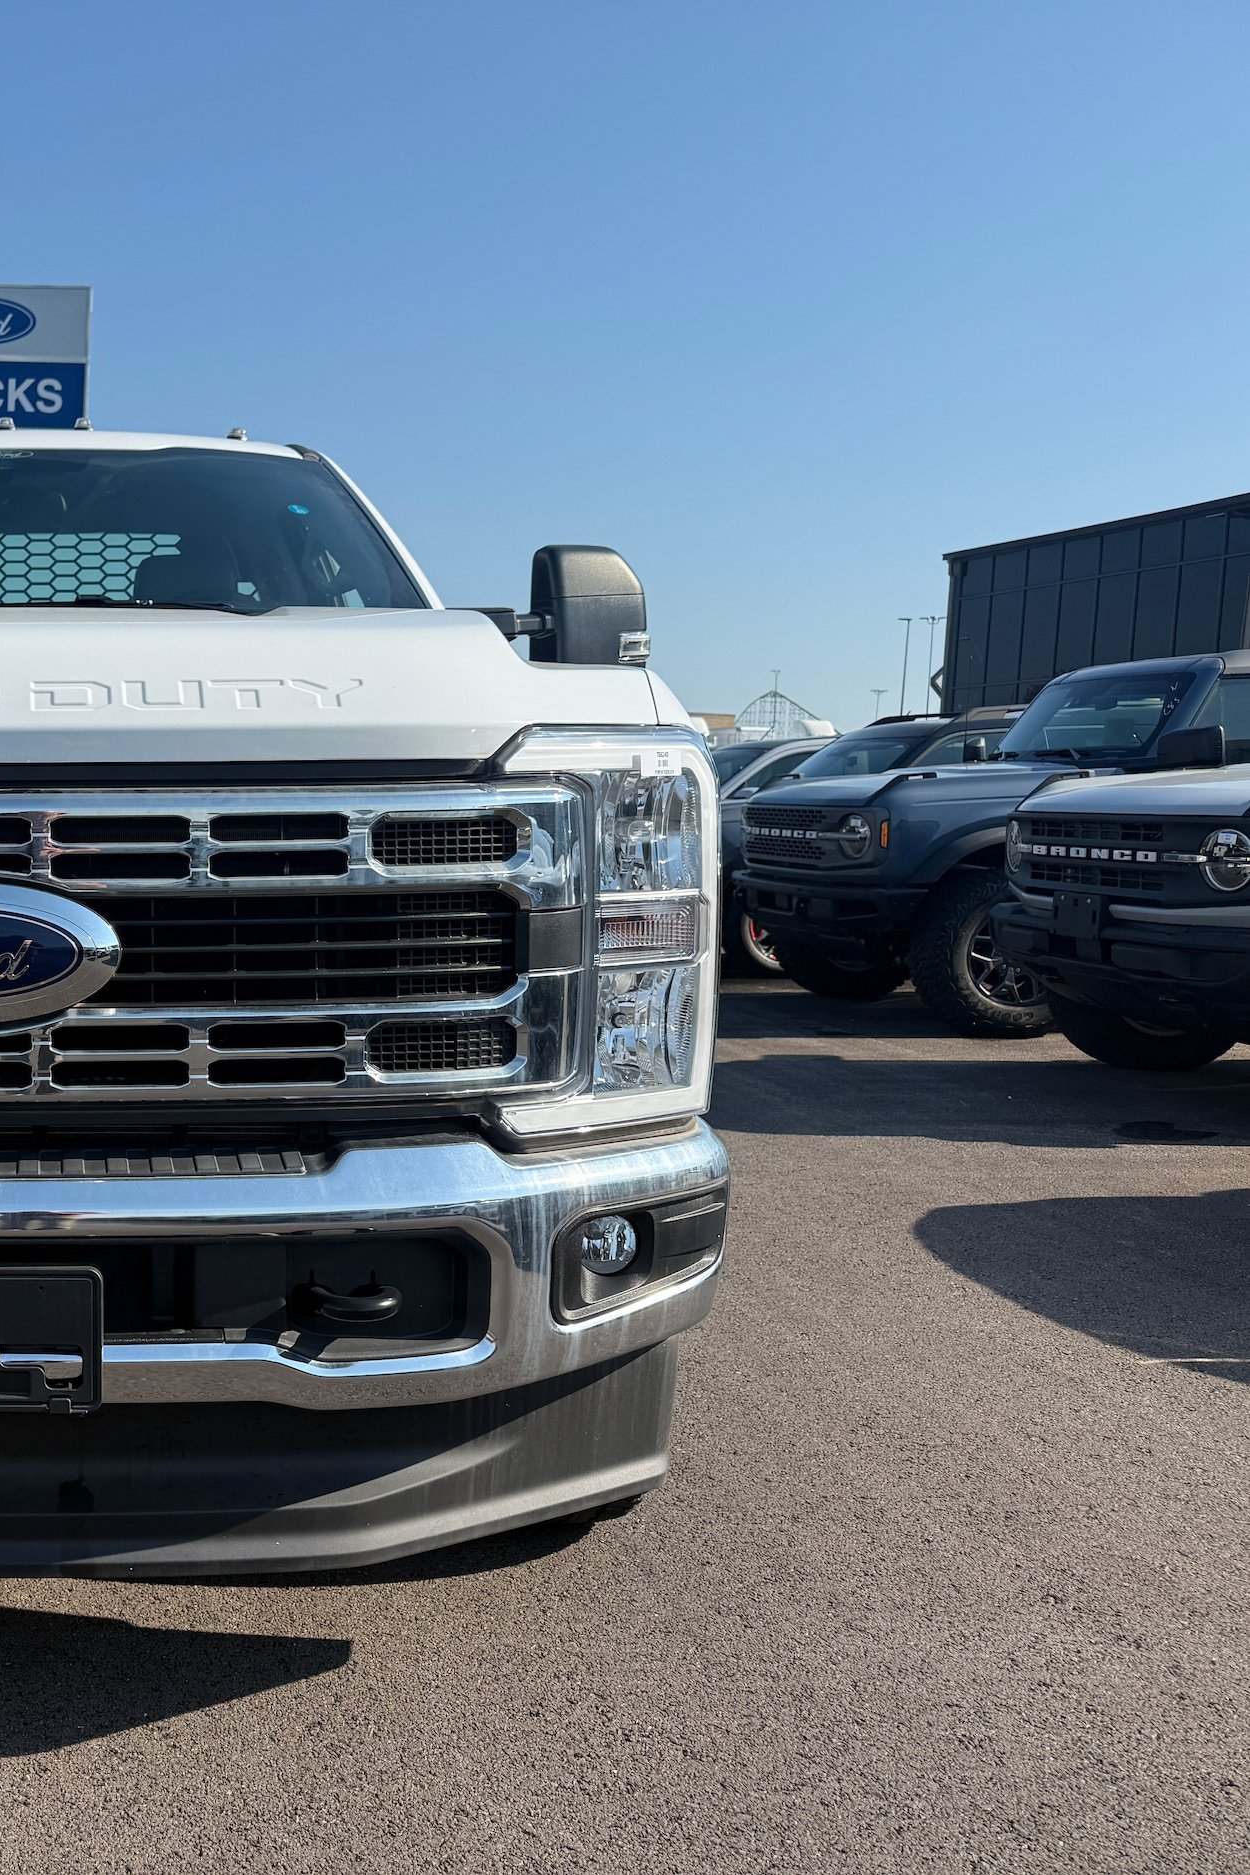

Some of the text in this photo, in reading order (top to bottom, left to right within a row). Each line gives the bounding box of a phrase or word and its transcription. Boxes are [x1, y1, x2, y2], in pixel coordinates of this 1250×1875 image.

[30, 678, 364, 712] DUTY
[751, 826, 818, 839] BRONCO
[1032, 844, 1158, 863] BRONCO
